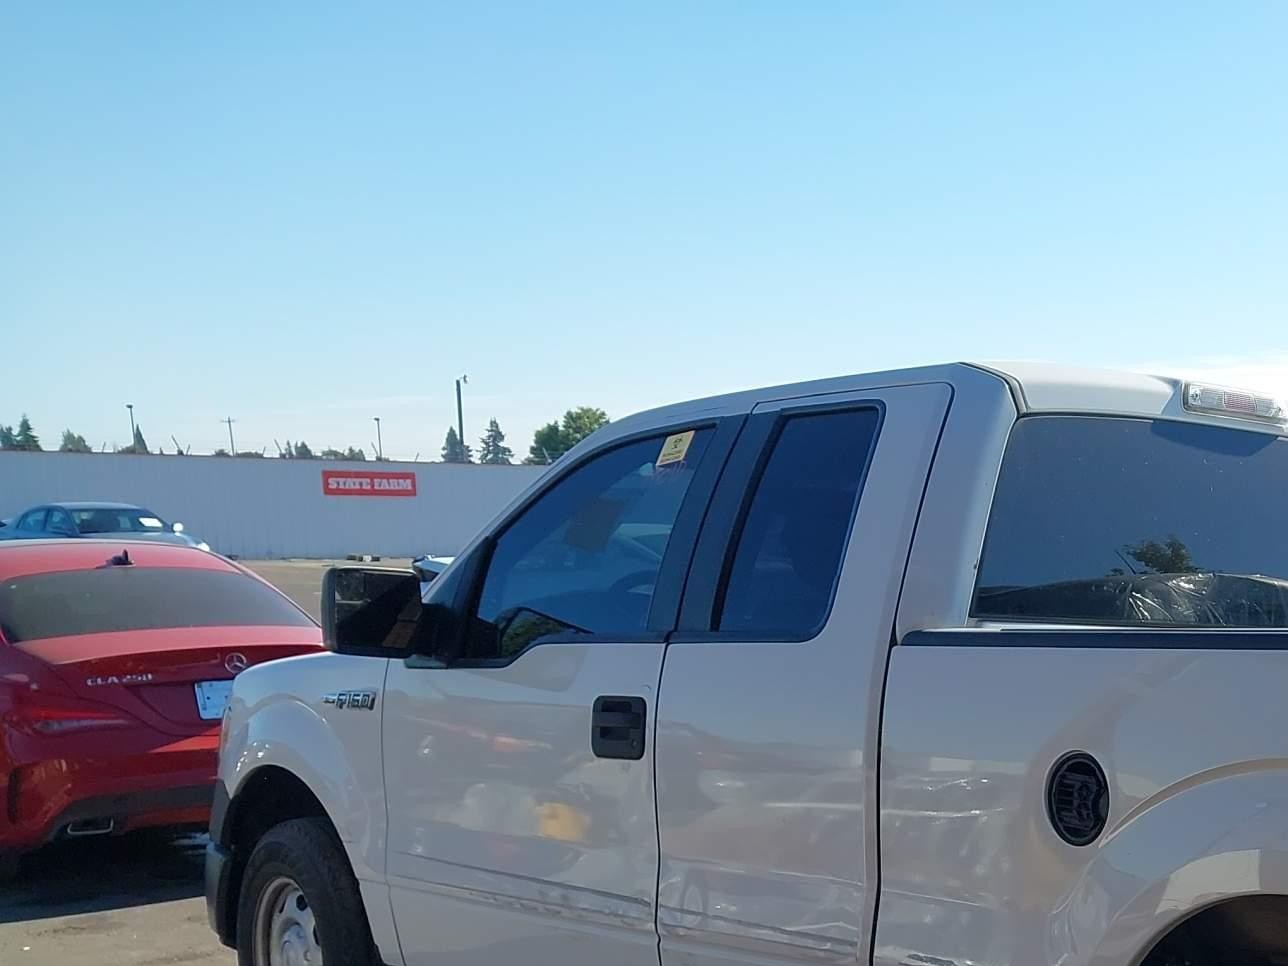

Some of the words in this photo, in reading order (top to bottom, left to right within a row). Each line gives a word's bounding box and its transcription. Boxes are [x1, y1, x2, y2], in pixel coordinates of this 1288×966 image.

[328, 478, 370, 489] STATE
[373, 479, 412, 490] FARM
[87, 676, 119, 686] CLA
